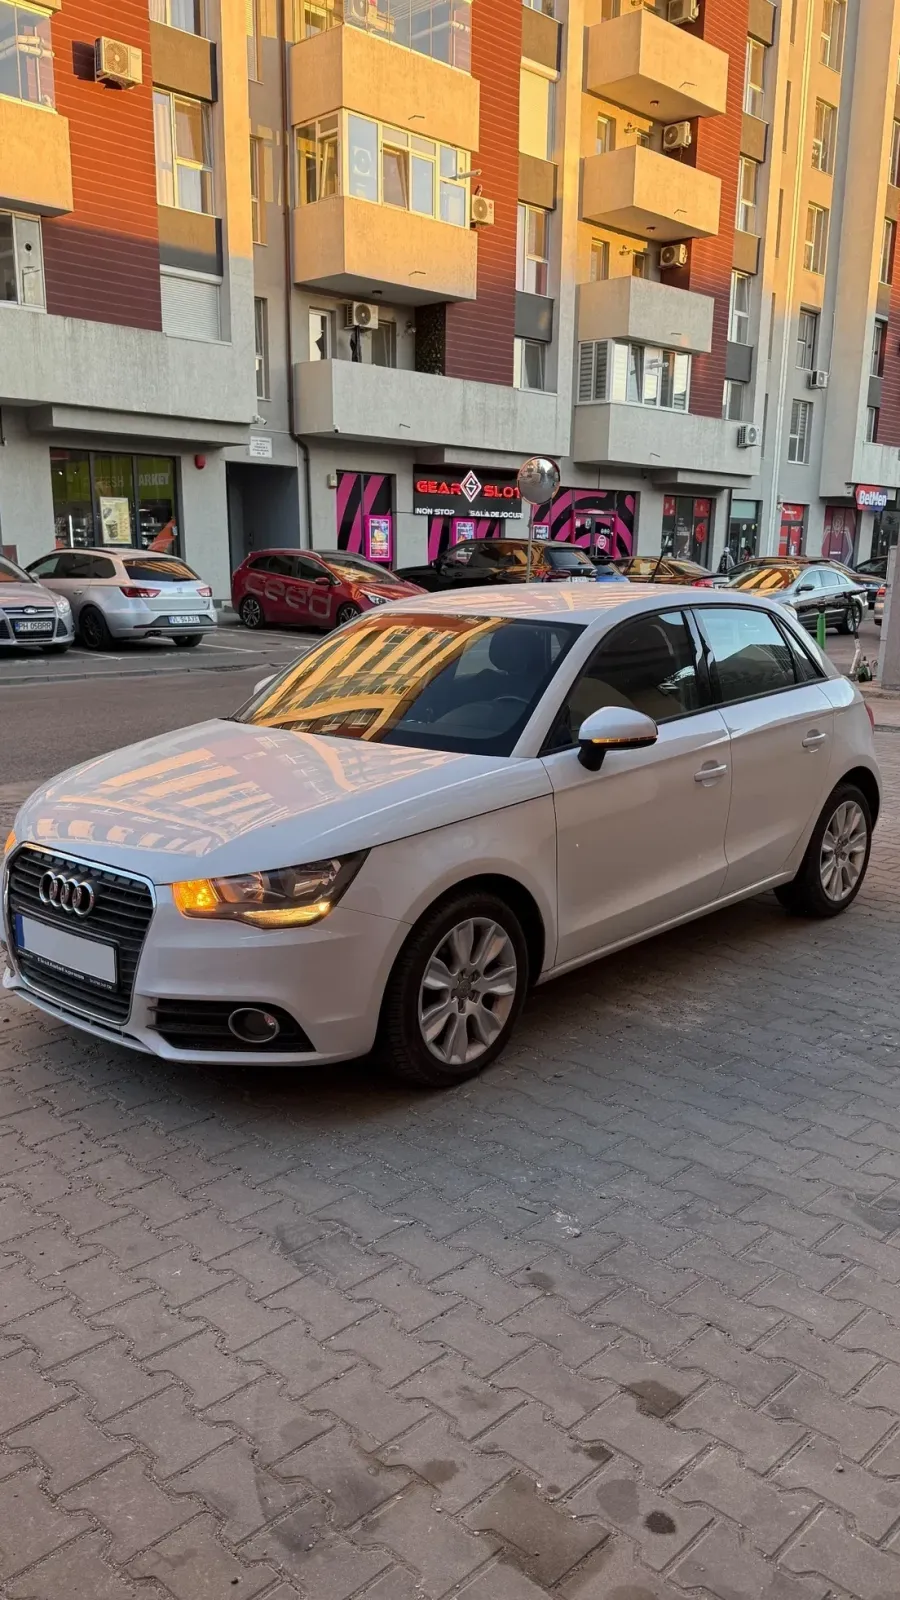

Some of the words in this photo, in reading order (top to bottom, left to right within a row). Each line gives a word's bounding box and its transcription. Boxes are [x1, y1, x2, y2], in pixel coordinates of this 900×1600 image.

[130, 472, 168, 486] ARKET
[416, 481, 461, 495] GEAR
[858, 490, 887, 506] BetMen
[20, 622, 29, 630] PH
